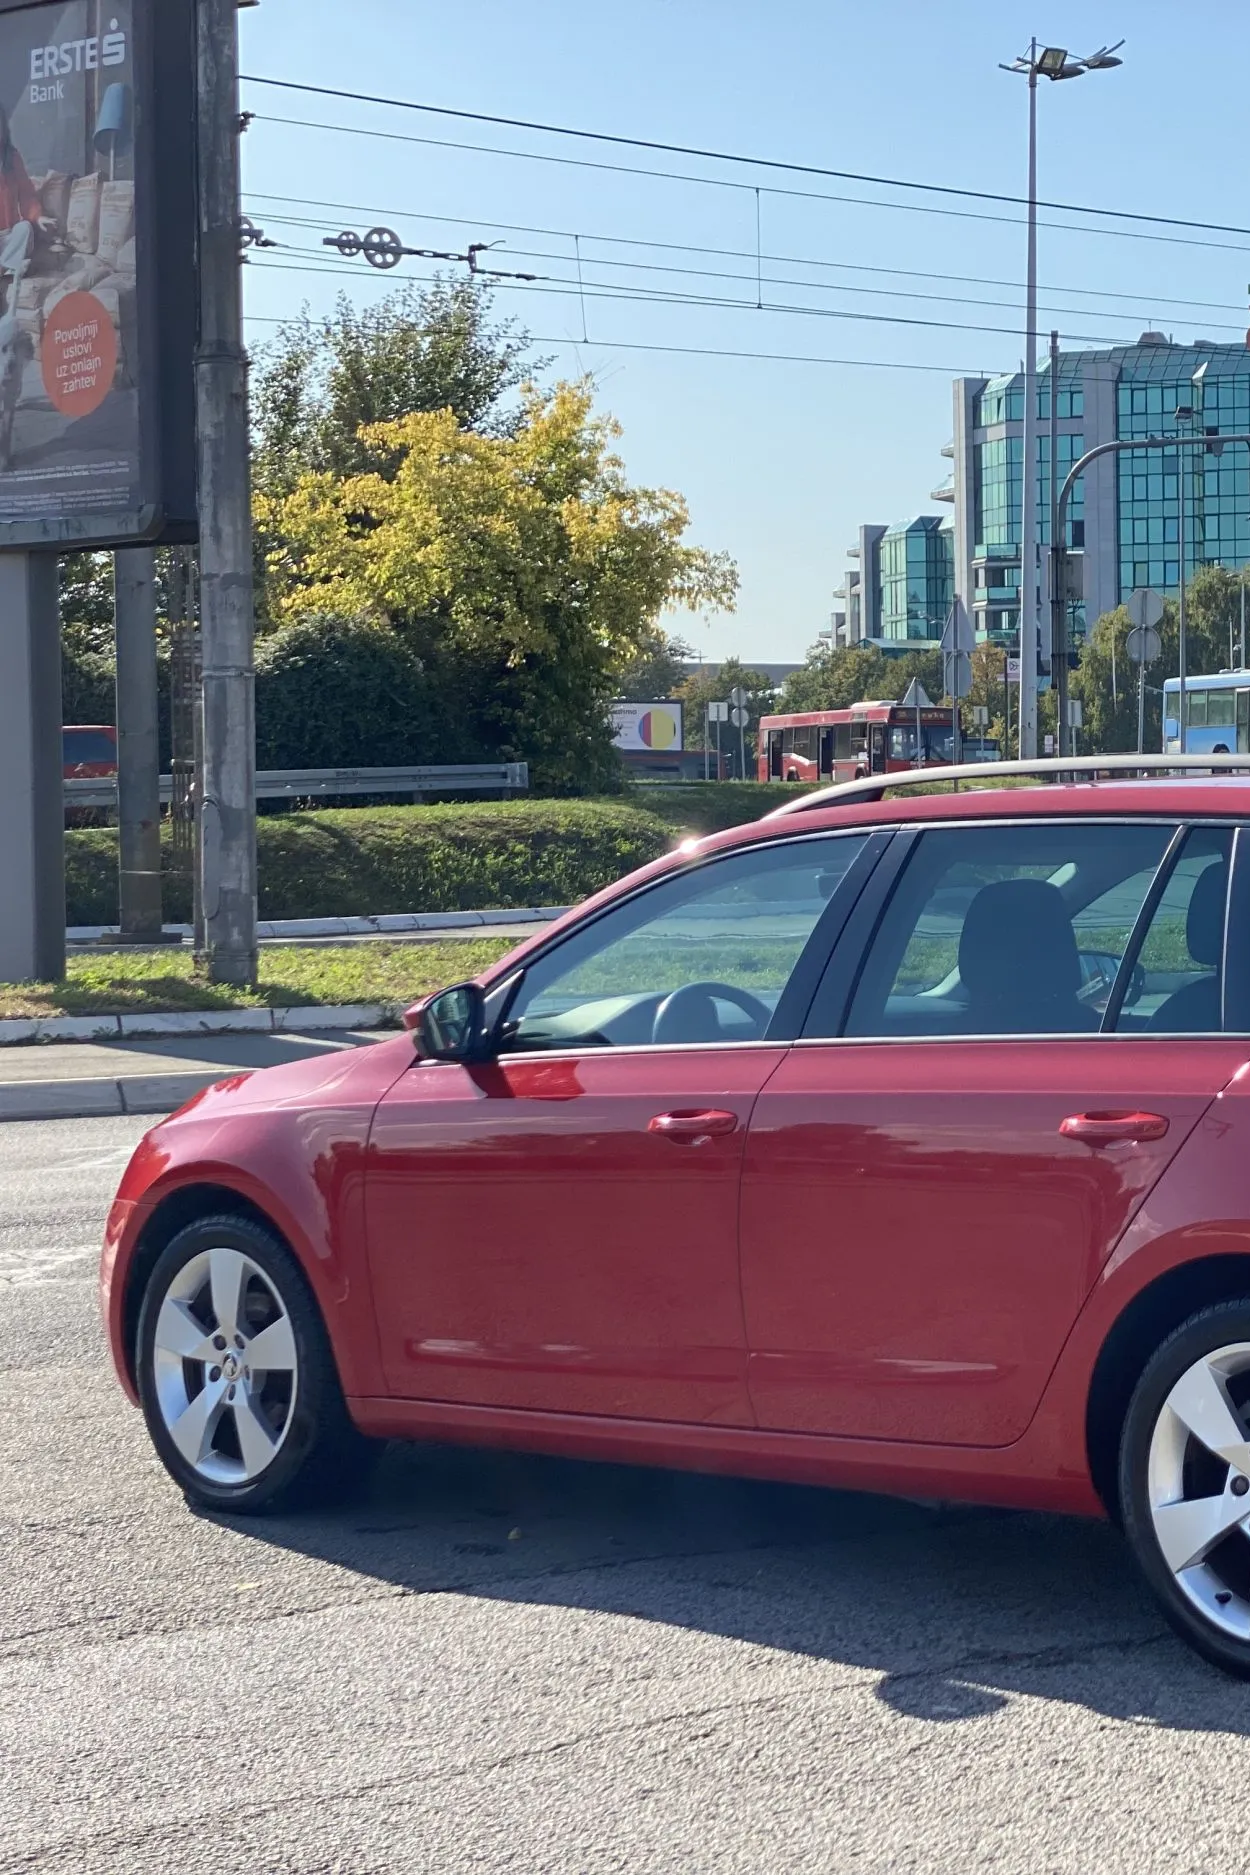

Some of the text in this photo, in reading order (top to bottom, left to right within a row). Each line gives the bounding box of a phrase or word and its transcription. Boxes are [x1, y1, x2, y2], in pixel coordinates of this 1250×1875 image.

[31, 37, 98, 80] ERSTE
[31, 80, 64, 103] Bank
[55, 320, 98, 344] Povoljniji
[63, 339, 92, 359] uslovi
[56, 355, 102, 378] uz onlajn
[63, 375, 96, 394] zahtev
